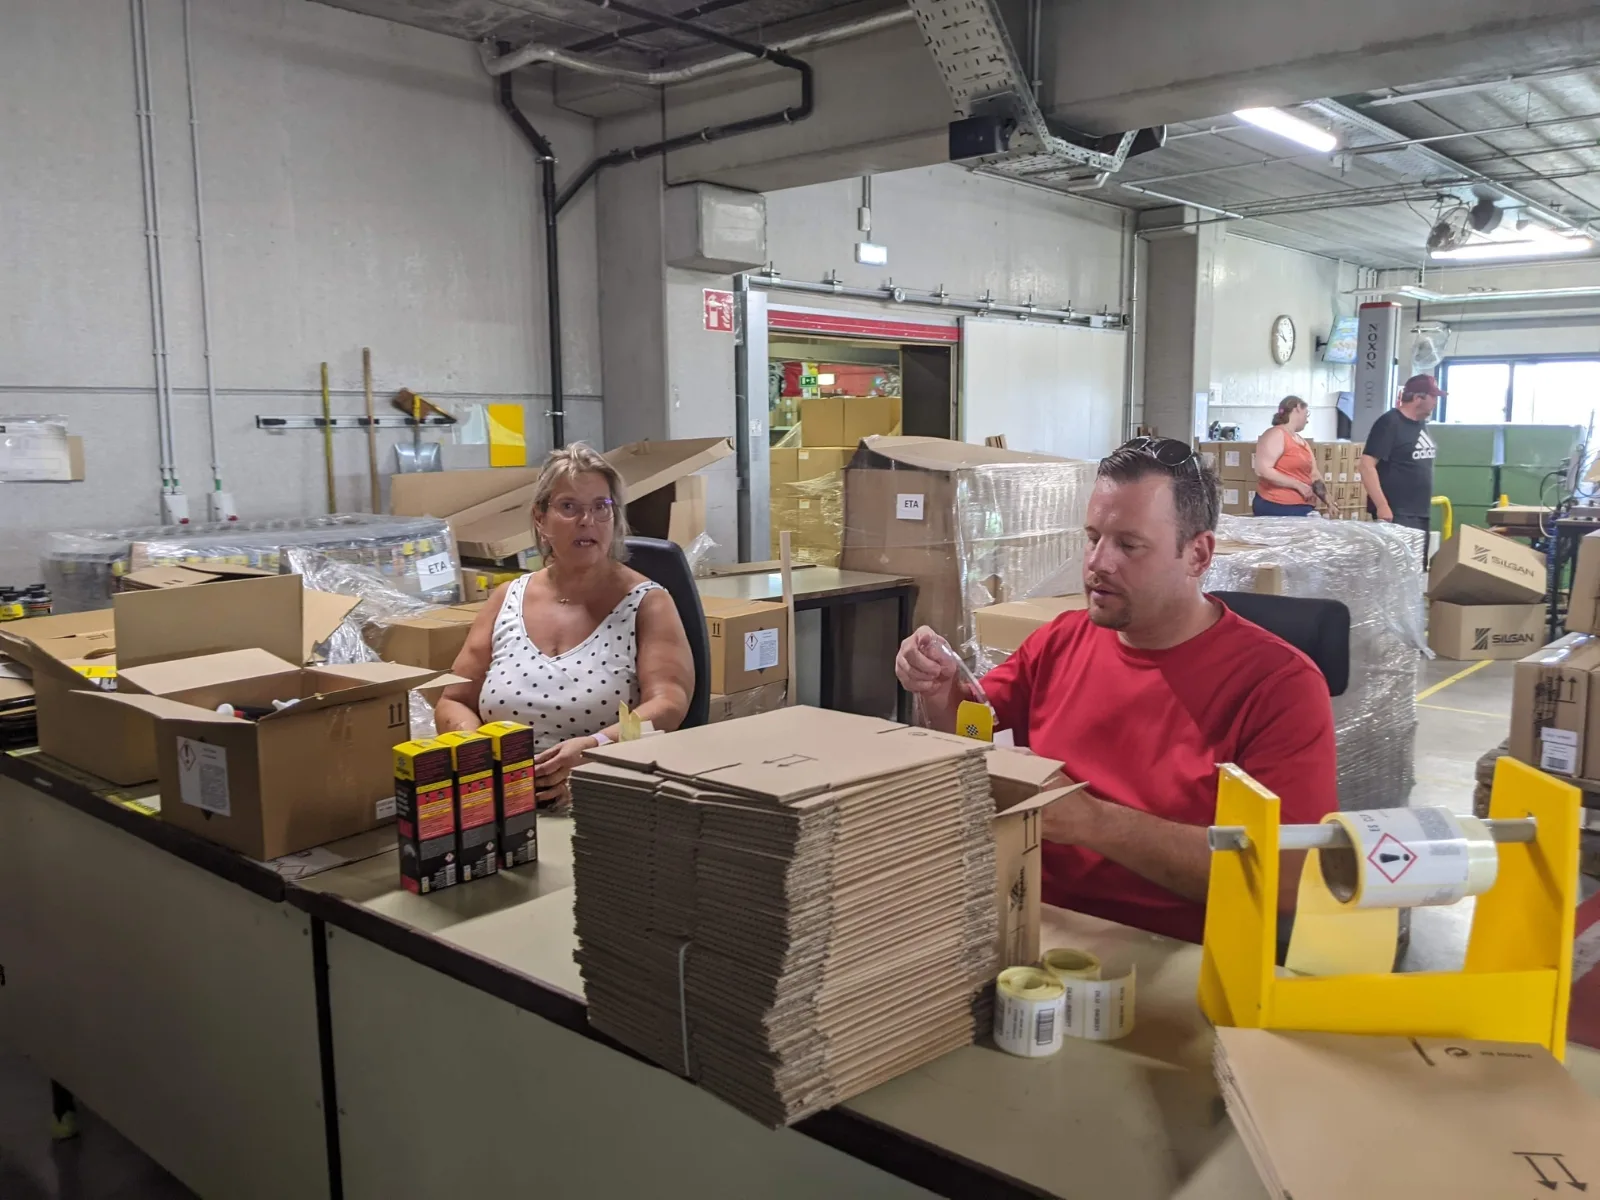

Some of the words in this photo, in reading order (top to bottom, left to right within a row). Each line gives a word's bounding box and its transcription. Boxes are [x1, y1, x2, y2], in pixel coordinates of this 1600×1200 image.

[1365, 323, 1378, 370] NOXON
[1412, 447, 1436, 460] adid
[904, 500, 919, 508] ETA
[428, 560, 448, 574] ETA
[1491, 556, 1535, 578] SILGAN
[1492, 633, 1535, 644] SILGAN
